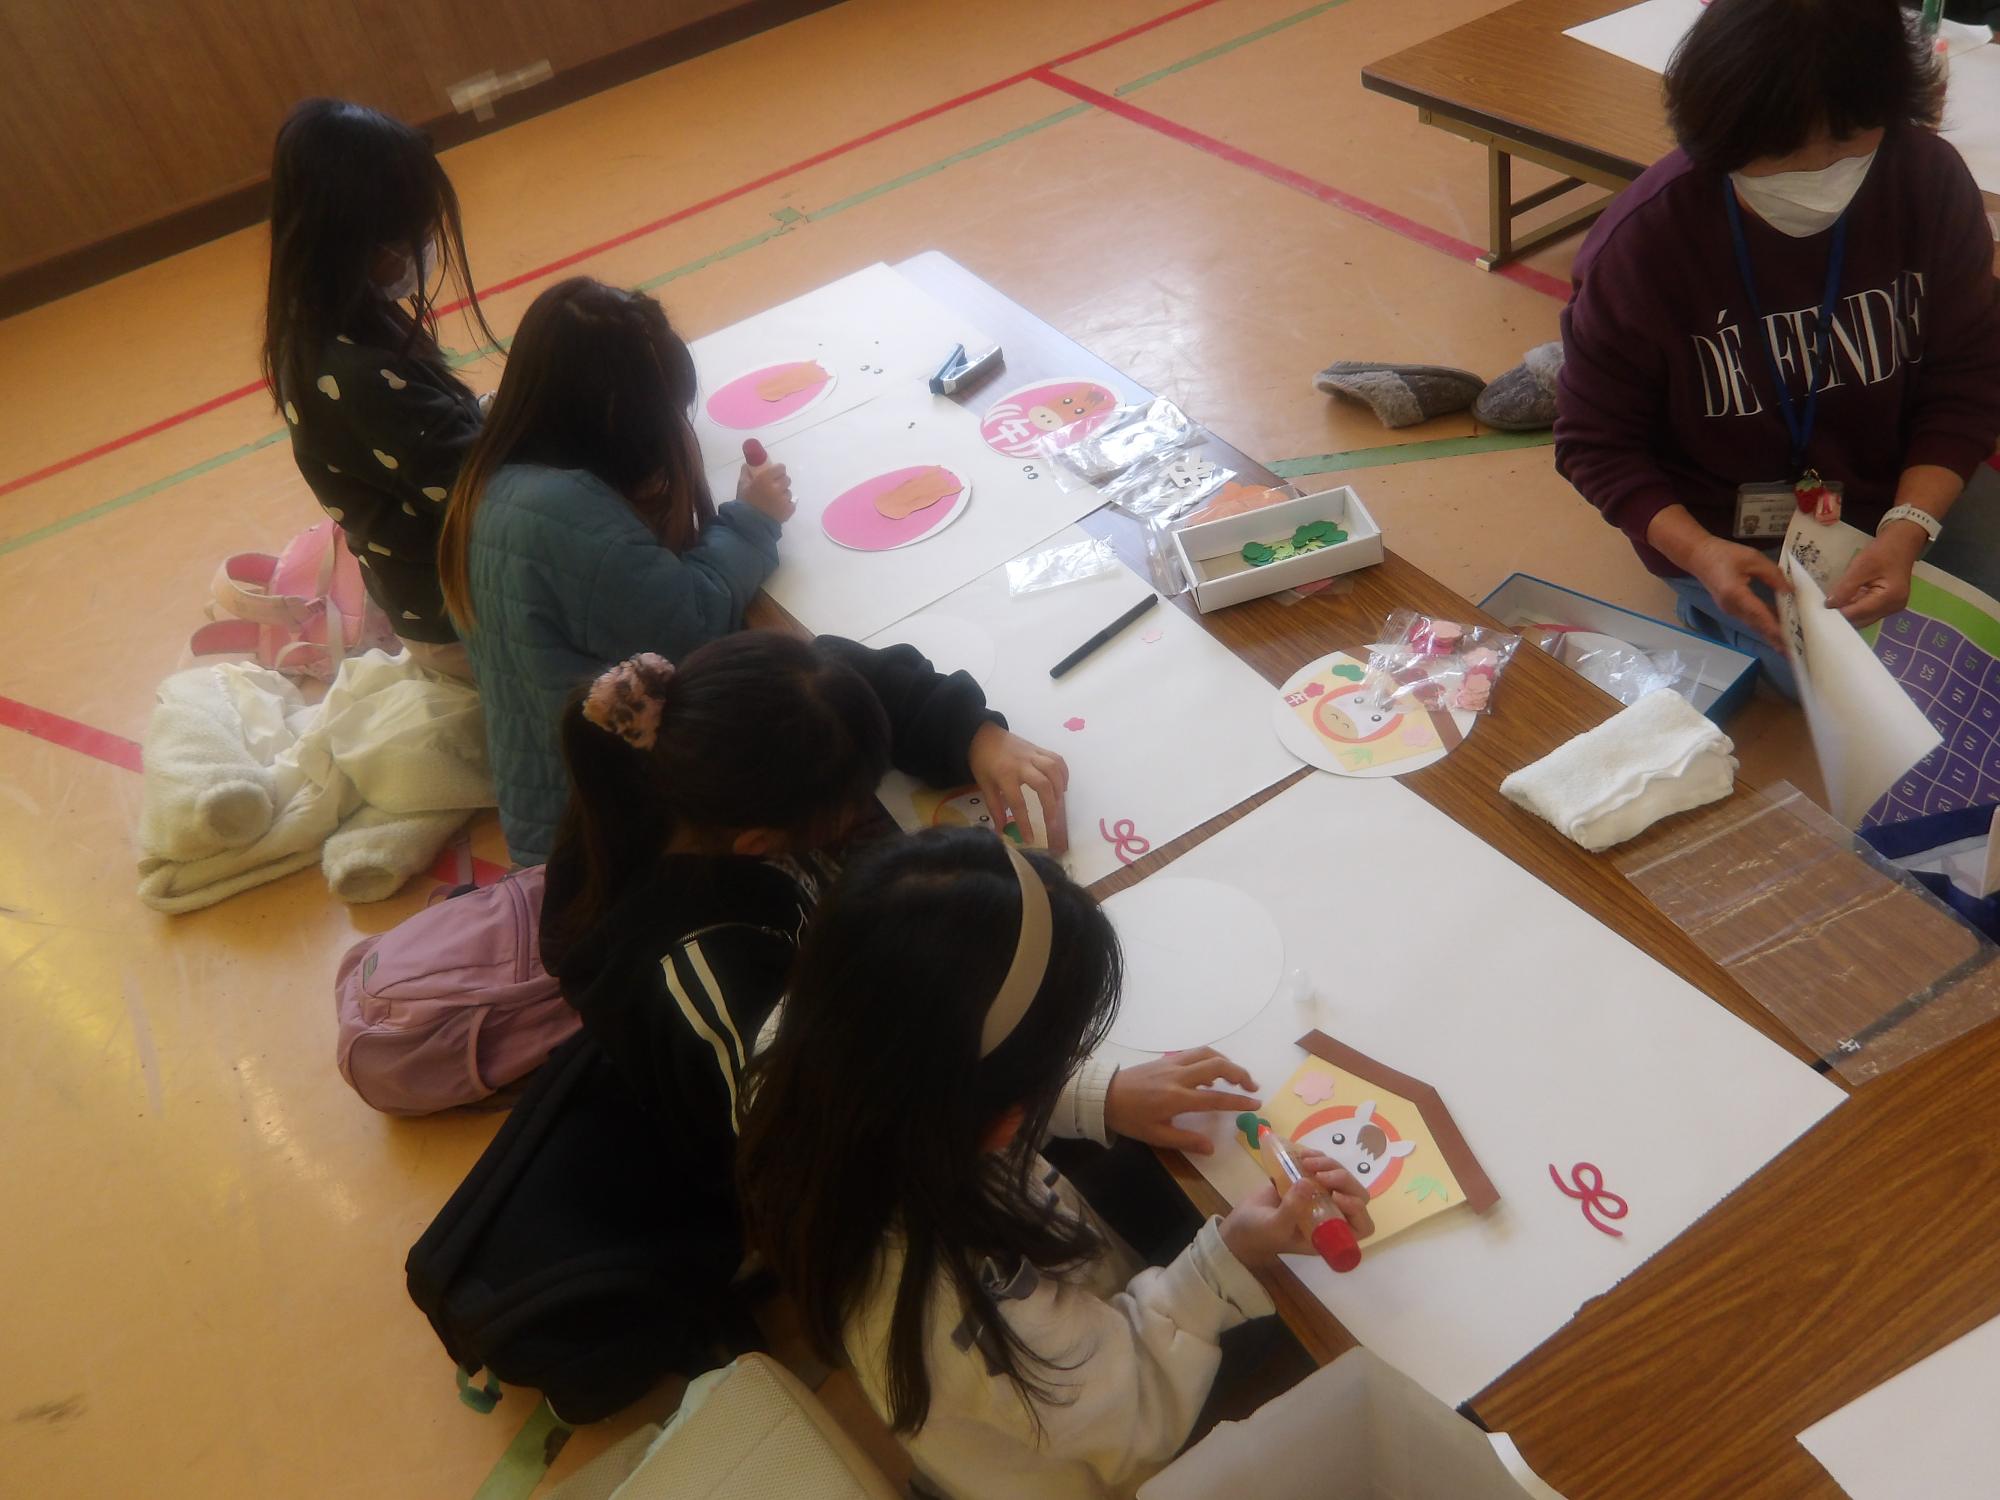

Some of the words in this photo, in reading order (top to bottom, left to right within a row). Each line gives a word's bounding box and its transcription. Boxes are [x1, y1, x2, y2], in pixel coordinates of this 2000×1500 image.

[1919, 664, 1936, 681] 23
[1951, 688, 1966, 703] 16
[1983, 707, 1993, 718] 9
[1963, 735, 1977, 750] 10
[1951, 768, 1966, 783] 11
[1902, 780, 1917, 796] 19
